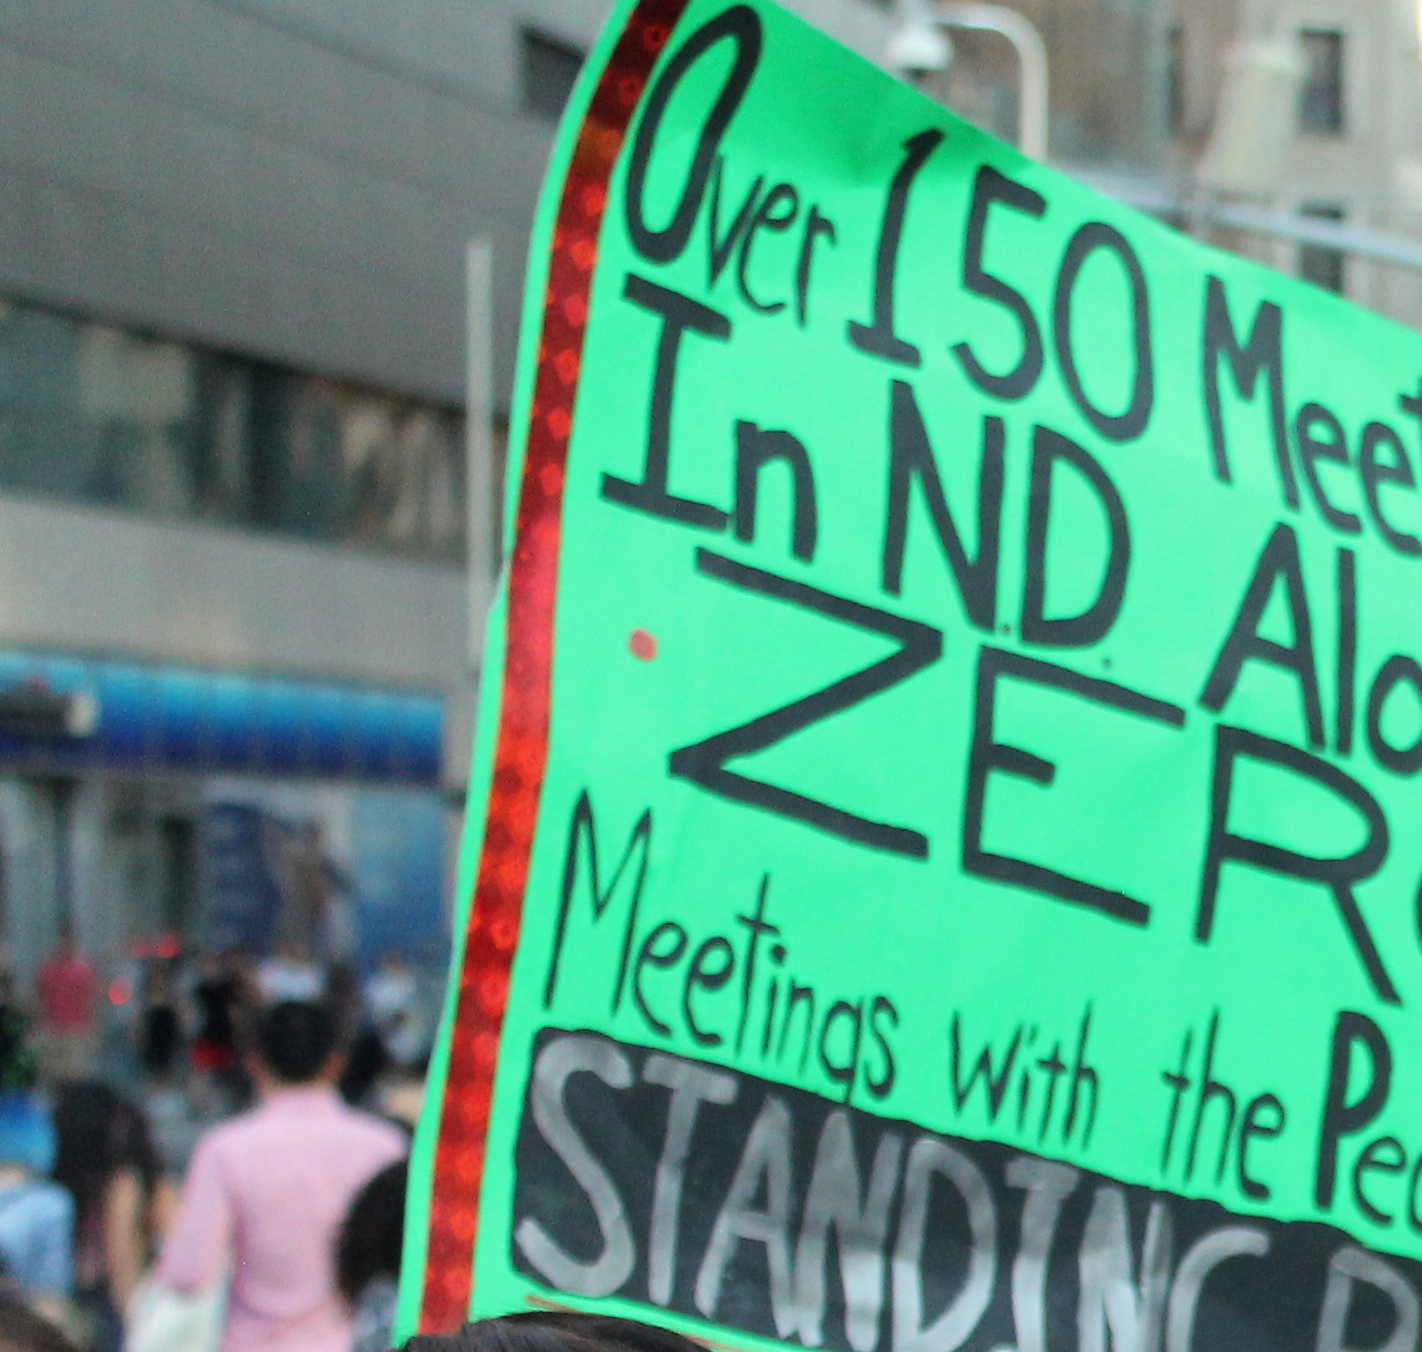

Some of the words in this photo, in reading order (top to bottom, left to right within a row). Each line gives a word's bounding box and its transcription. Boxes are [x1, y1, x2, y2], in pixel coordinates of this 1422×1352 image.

[600, 273, 817, 565] In
[623, 4, 836, 326] Over
[846, 128, 1154, 444] 150
[543, 787, 899, 1103] Meetings
[1161, 1005, 1286, 1200] the
